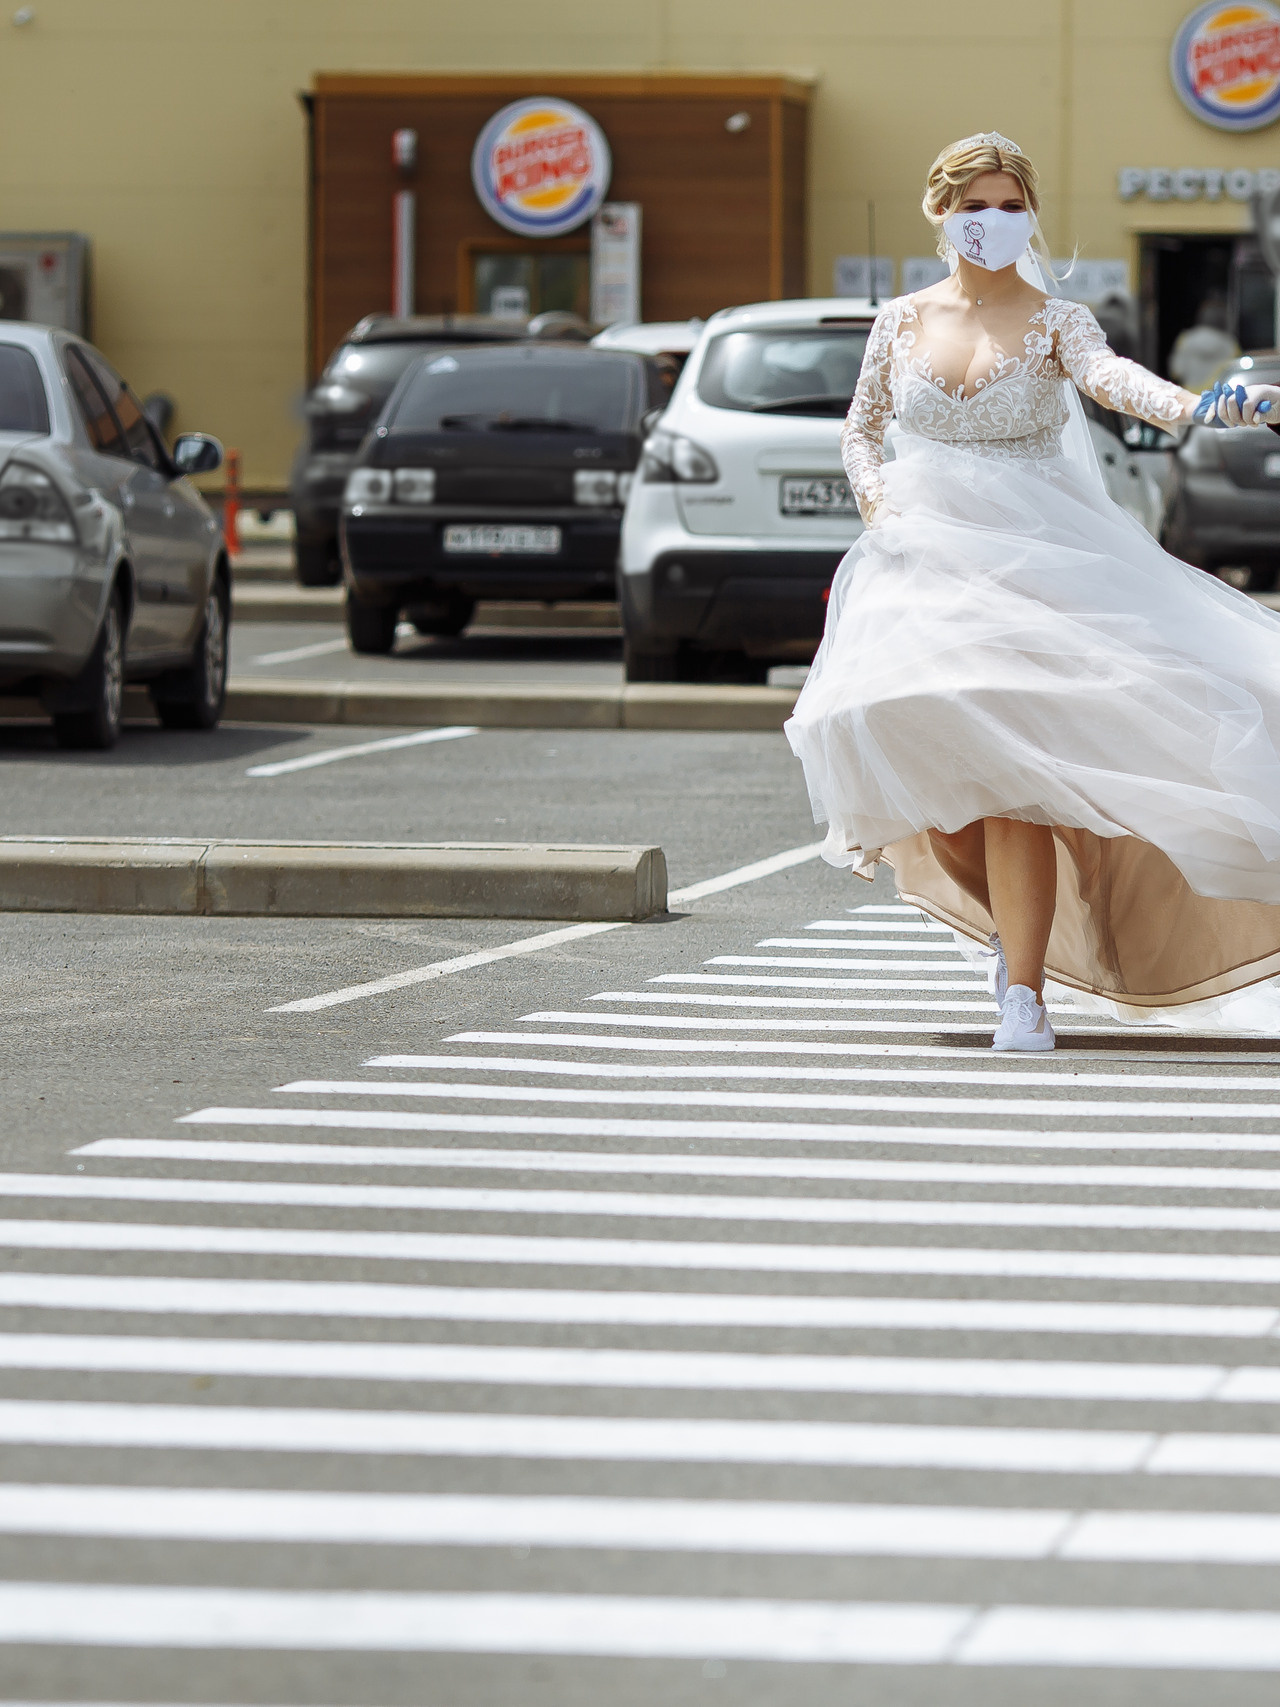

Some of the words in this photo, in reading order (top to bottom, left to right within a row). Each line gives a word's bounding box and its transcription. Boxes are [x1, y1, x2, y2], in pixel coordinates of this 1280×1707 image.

[496, 127, 585, 166] BURGER
[496, 147, 591, 202] KING
[788, 481, 857, 505] Н439
